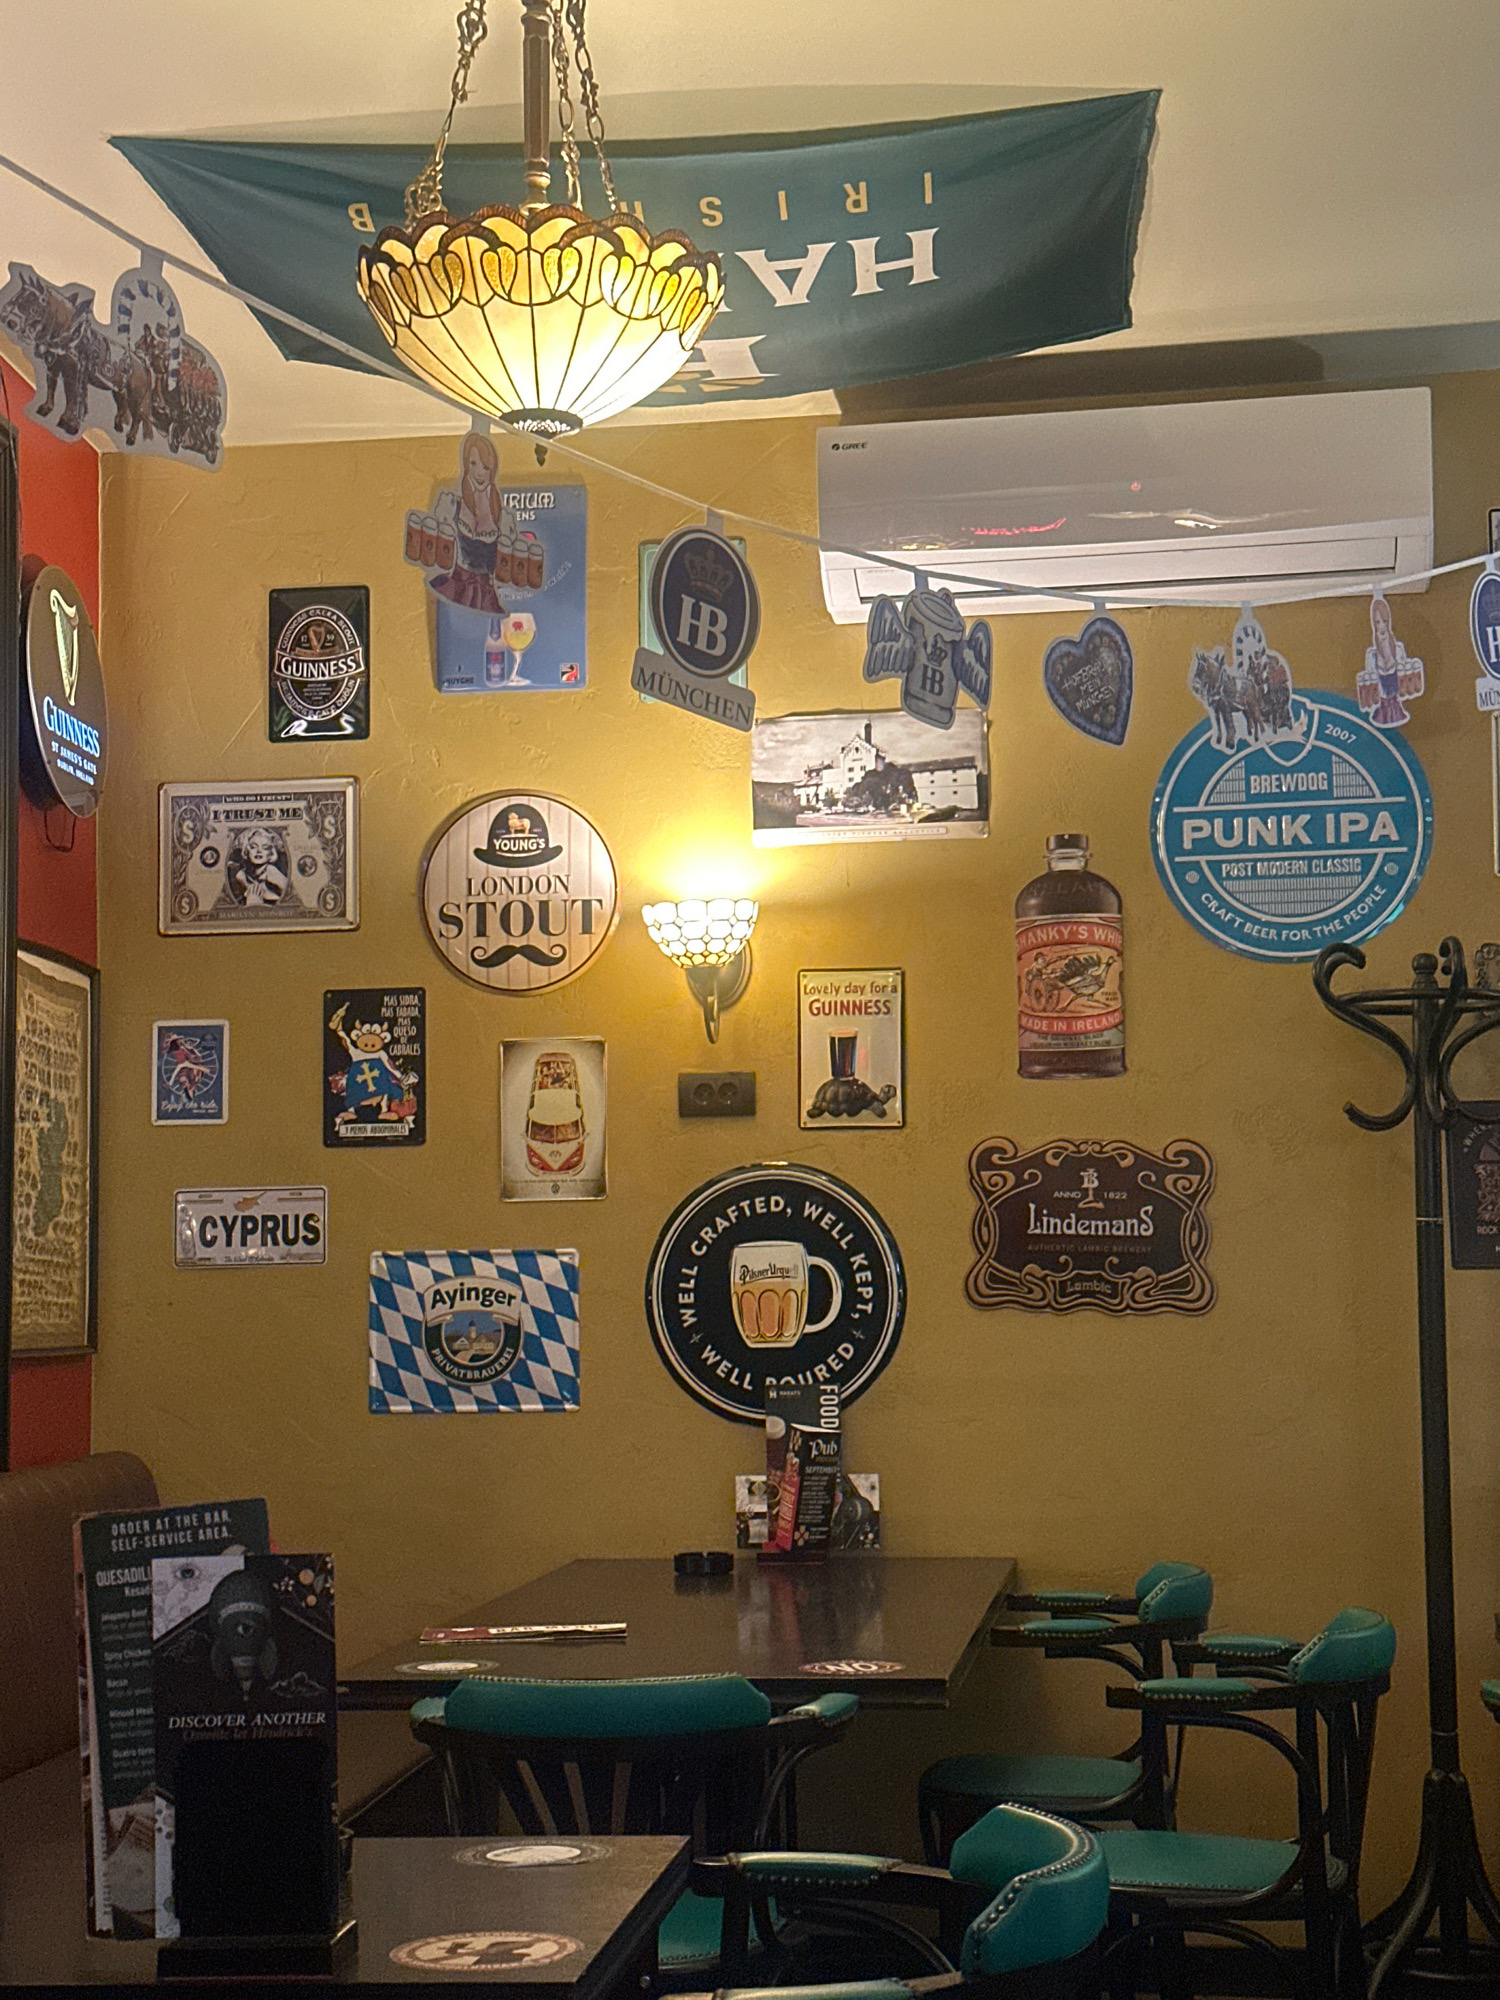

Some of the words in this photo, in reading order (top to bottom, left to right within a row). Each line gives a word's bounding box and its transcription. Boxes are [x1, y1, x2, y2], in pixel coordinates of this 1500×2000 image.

[841, 442, 868, 451] GREE
[676, 593, 728, 657] HB
[280, 655, 356, 680] GUINNESS
[920, 663, 944, 697] HB
[636, 666, 750, 726] MÜNCHEN
[43, 695, 100, 758] GUINNESS
[1324, 722, 1358, 745] 2007
[83, 759, 97, 775] GATE
[1250, 772, 1328, 795] BREWDOG
[222, 808, 276, 821] TRUST
[278, 807, 303, 819] ME
[1182, 813, 1313, 851] PUNK
[1325, 810, 1400, 845] IPA
[493, 837, 546, 851] YOUNG'S
[1221, 861, 1254, 878] POST
[1256, 860, 1309, 877] MODERN
[1311, 857, 1362, 874] CLASSIC
[466, 874, 571, 897] LONDON
[438, 898, 604, 940] STOUT
[1201, 892, 1243, 929] CRAFT
[1243, 921, 1278, 941] BEER
[1281, 929, 1312, 941] FOR
[1312, 918, 1344, 938] THE
[1345, 884, 1387, 926] PEOPLE
[803, 982, 841, 997] Lovely
[844, 981, 867, 997] day
[870, 981, 888, 995] for
[890, 984, 898, 994] a
[808, 998, 892, 1017] GUINNESS
[393, 1025, 417, 1038] QUESO
[1020, 1015, 1049, 1031] MADE
[1053, 1023, 1067, 1031] IN
[1072, 1013, 1121, 1031] IRELAND
[1053, 1191, 1082, 1199] ANNO
[1103, 1191, 1128, 1200] 1822
[199, 1212, 321, 1249] CYPRUS
[1476, 1225, 1498, 1235] ROCK
[679, 1265, 699, 1328] WELL
[689, 1195, 793, 1258] CRAFTED,
[802, 1201, 855, 1250] WELL
[849, 1252, 874, 1320] KEPT,
[431, 1281, 517, 1310] Ayinger
[1065, 1280, 1112, 1294] Lambic
[431, 1347, 515, 1380] PRIVATBRAUEREI
[700, 1344, 754, 1391] WELL
[820, 1385, 839, 1428] FOOD
[808, 1439, 838, 1459] Pub
[111, 1518, 150, 1537] ORDER
[155, 1517, 170, 1531] AT
[175, 1513, 199, 1528] THE
[111, 1531, 194, 1552] SELF-SERVICE
[168, 1714, 246, 1729] DISCOVER
[251, 1711, 327, 1726] ANOTHER
